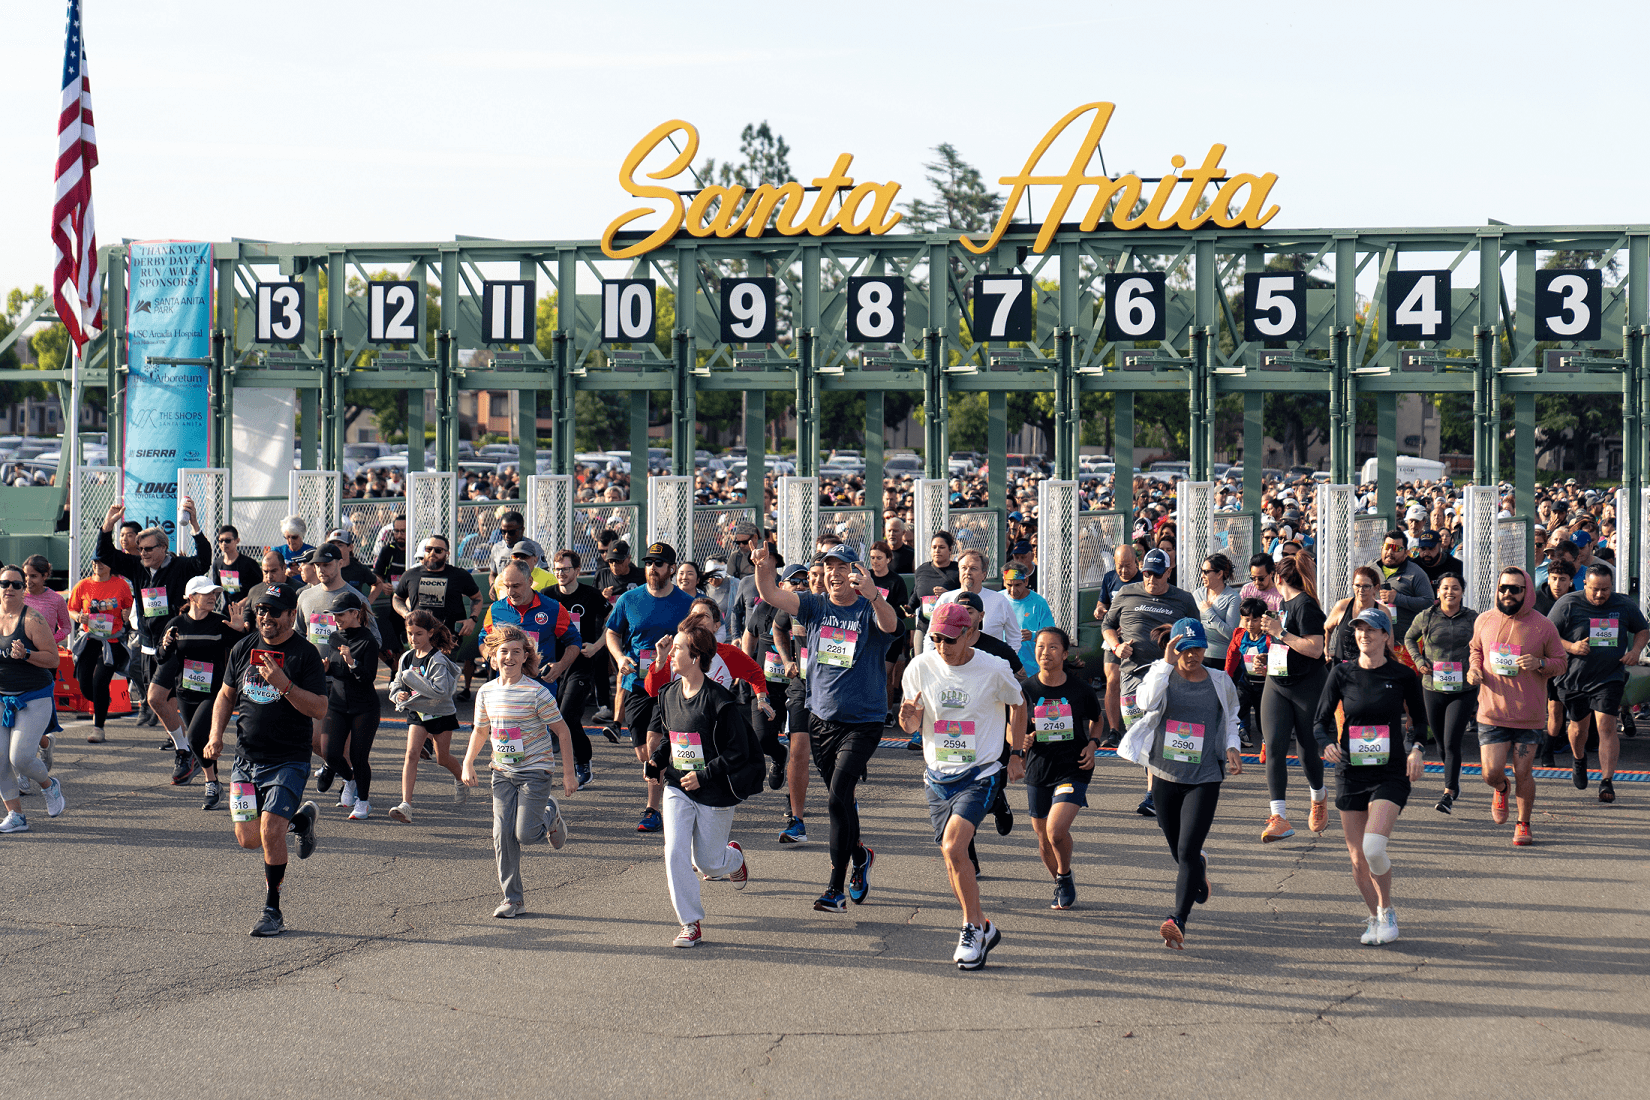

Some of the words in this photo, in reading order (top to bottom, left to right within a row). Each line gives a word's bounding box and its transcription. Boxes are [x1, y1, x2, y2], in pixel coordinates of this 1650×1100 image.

[601, 119, 903, 259] Santa
[958, 101, 1279, 254] Anita
[140, 245, 176, 256] THANK
[178, 244, 201, 254] YOU
[134, 257, 167, 268] DERBY
[169, 256, 191, 266] DAY
[141, 267, 161, 277] RUN
[169, 266, 198, 276] WALK
[140, 277, 199, 288] SPONSORS!
[154, 297, 181, 306] SANTA
[181, 296, 206, 305] ANITA
[1114, 277, 1156, 336] 6
[1253, 276, 1297, 336] 5
[1395, 275, 1442, 335] 4
[1545, 274, 1591, 336] 3
[153, 305, 175, 314] PARK
[258, 286, 302, 339] 13
[371, 285, 415, 339] 12
[491, 285, 525, 339] 11
[604, 283, 653, 338] 10
[730, 282, 767, 338] 9
[856, 281, 895, 338] 8
[982, 279, 1023, 337] 7
[133, 329, 148, 339] USC
[174, 328, 203, 340] Hospital
[155, 373, 203, 383] Arboretum
[159, 411, 173, 420] THE
[174, 411, 203, 420] SHOPS
[135, 449, 177, 458] SIERRA
[826, 644, 847, 655] 2281
[769, 666, 786, 675] 3110
[256, 690, 281, 699] VEGAS
[1043, 722, 1065, 731] 2749
[496, 744, 516, 753] 2278
[943, 740, 966, 749] 2594
[1171, 739, 1195, 750] 2590
[1358, 744, 1381, 753] 2520
[676, 749, 696, 759] 2280
